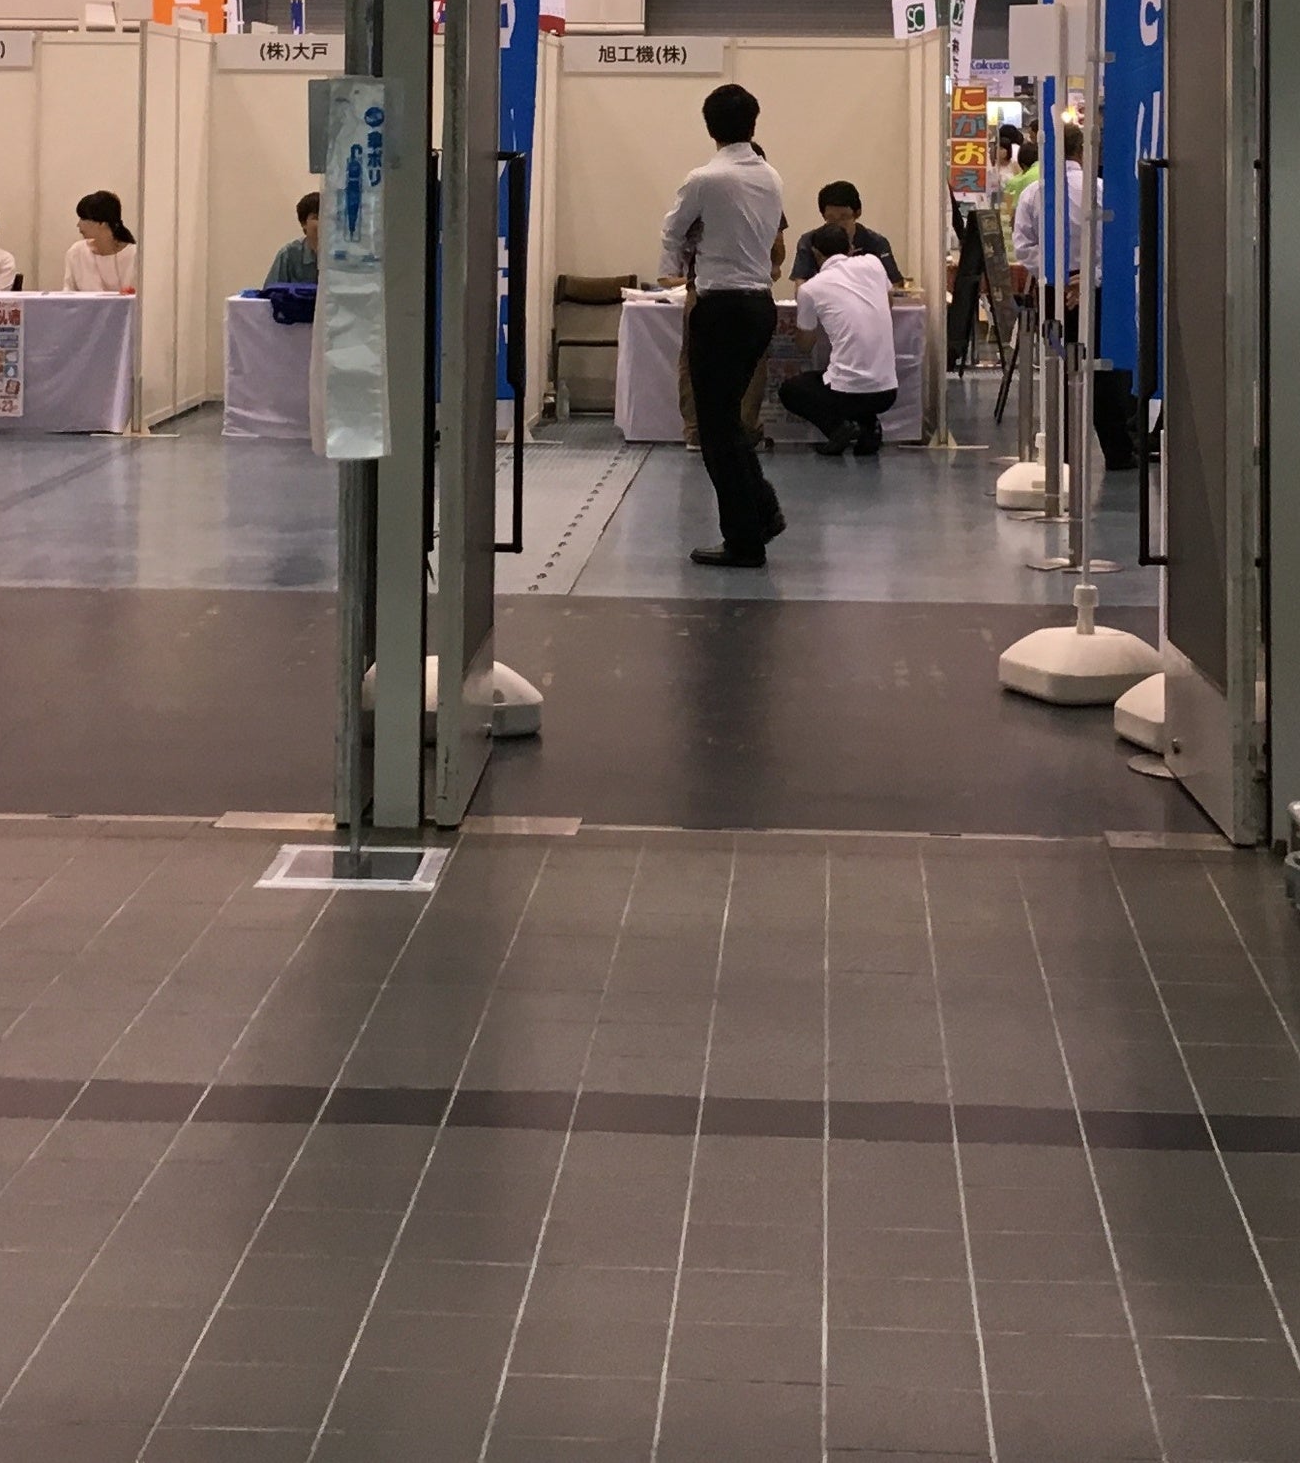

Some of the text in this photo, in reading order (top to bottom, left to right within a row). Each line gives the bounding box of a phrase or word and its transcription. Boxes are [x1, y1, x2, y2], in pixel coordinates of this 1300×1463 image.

[260, 41, 329, 61] (株)大戸
[598, 45, 688, 65] 旭工機(株)
[952, 87, 986, 192] にがおえ
